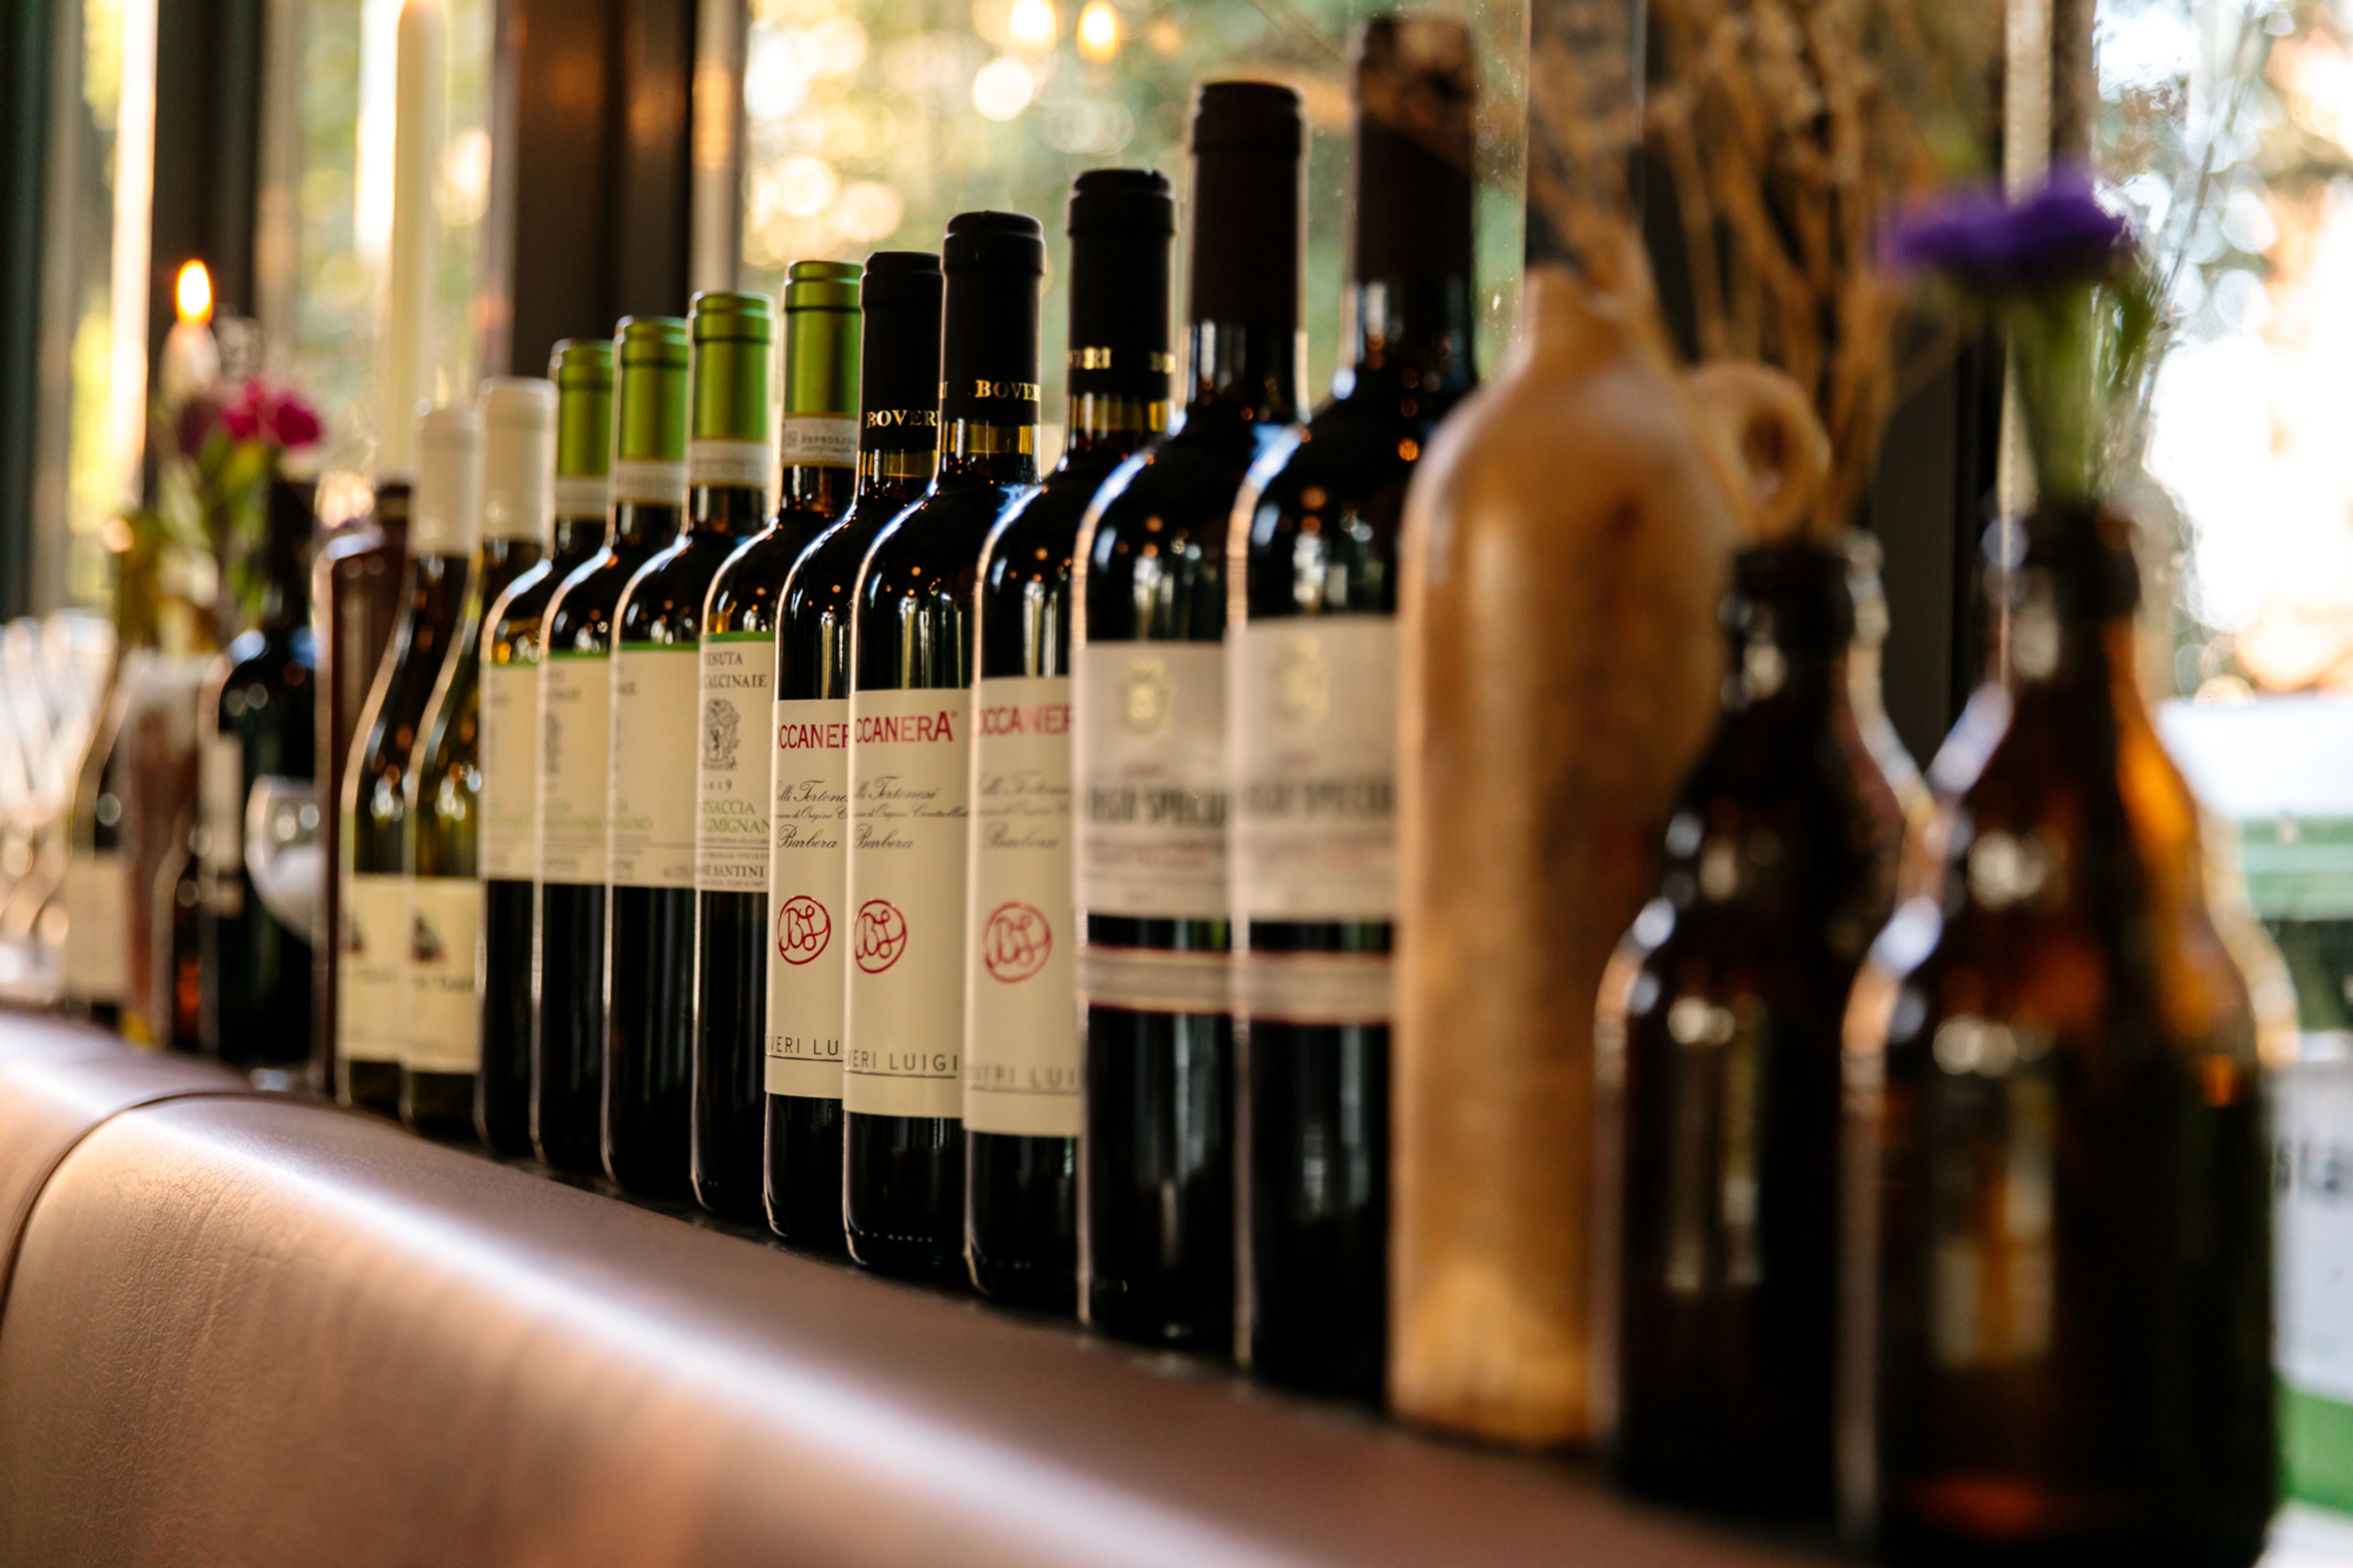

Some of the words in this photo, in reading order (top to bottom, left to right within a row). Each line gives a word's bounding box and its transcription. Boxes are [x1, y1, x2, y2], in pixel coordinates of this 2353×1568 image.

[801, 806, 832, 822] Origine
[776, 823, 838, 848] Barbera
[854, 823, 915, 849] Barbera
[889, 1052, 958, 1072] LUIGI
